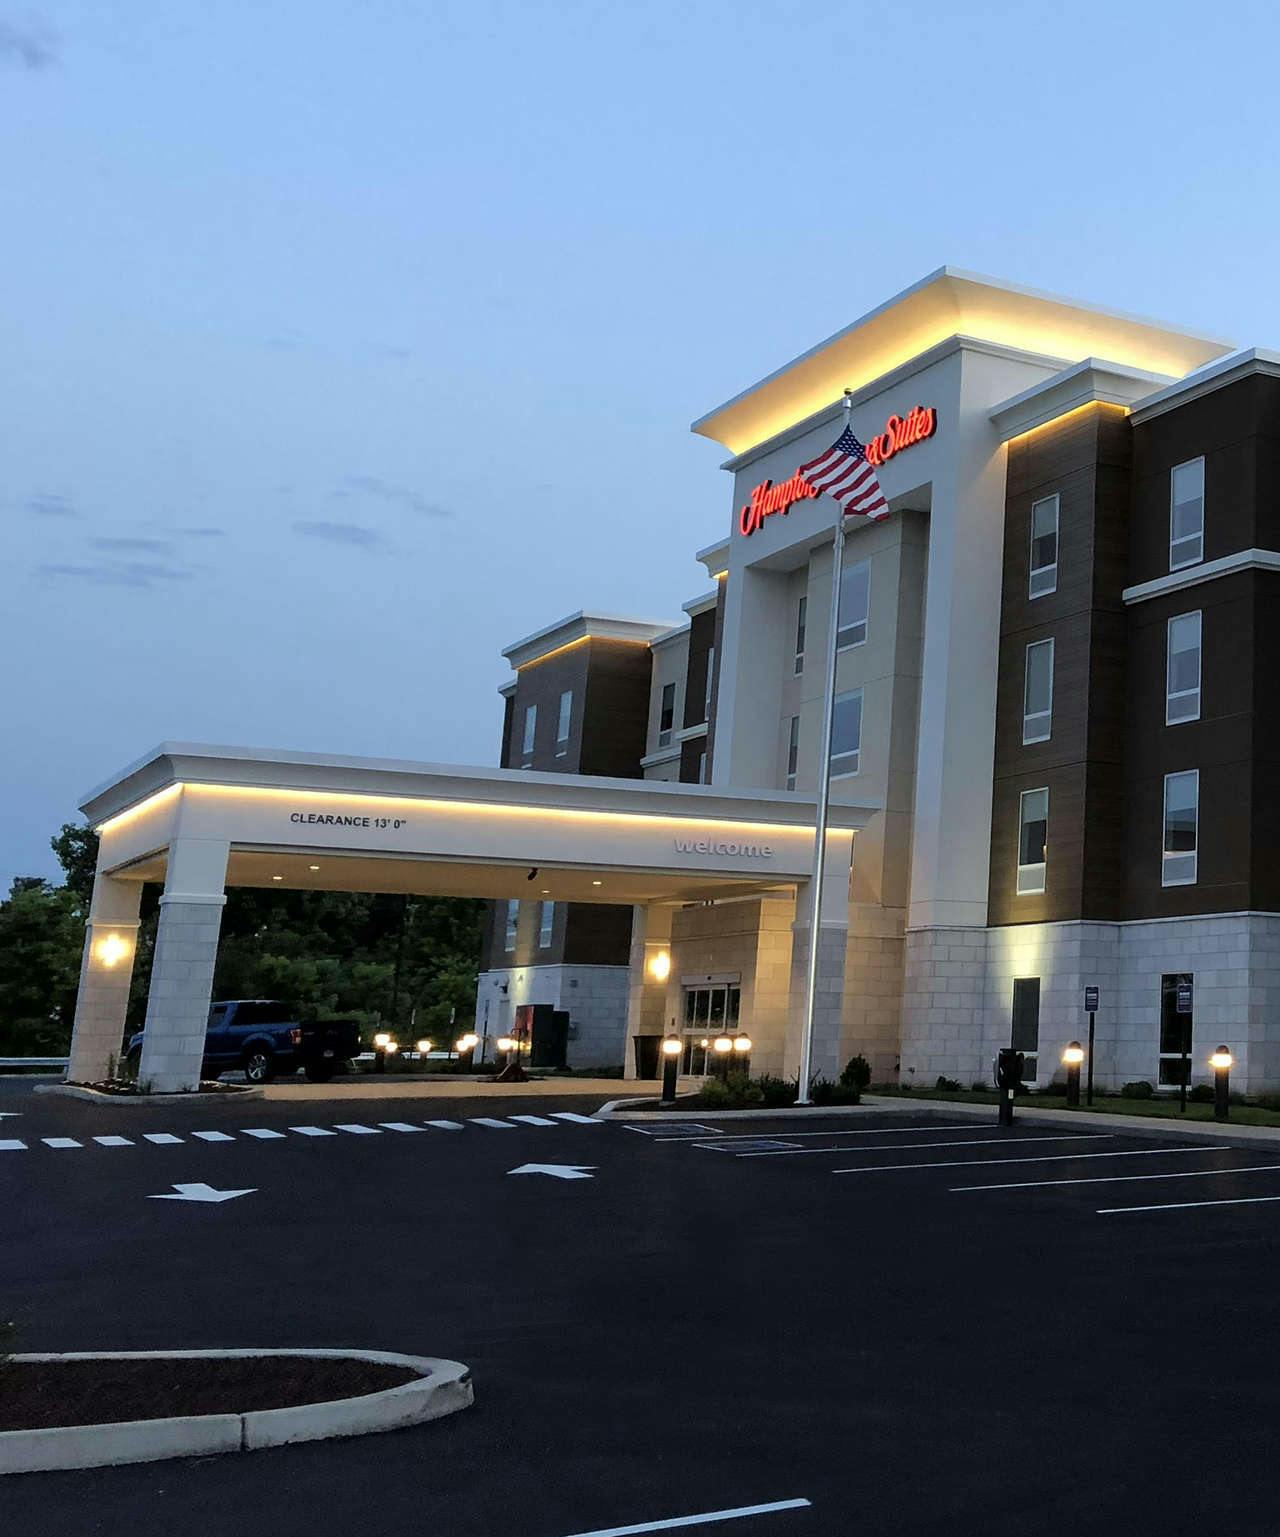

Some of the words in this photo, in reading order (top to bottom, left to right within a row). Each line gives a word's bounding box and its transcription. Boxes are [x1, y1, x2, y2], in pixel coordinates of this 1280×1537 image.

[880, 406, 937, 459] Suites
[290, 812, 370, 828] CLEARANCE
[674, 838, 774, 858] welcome
